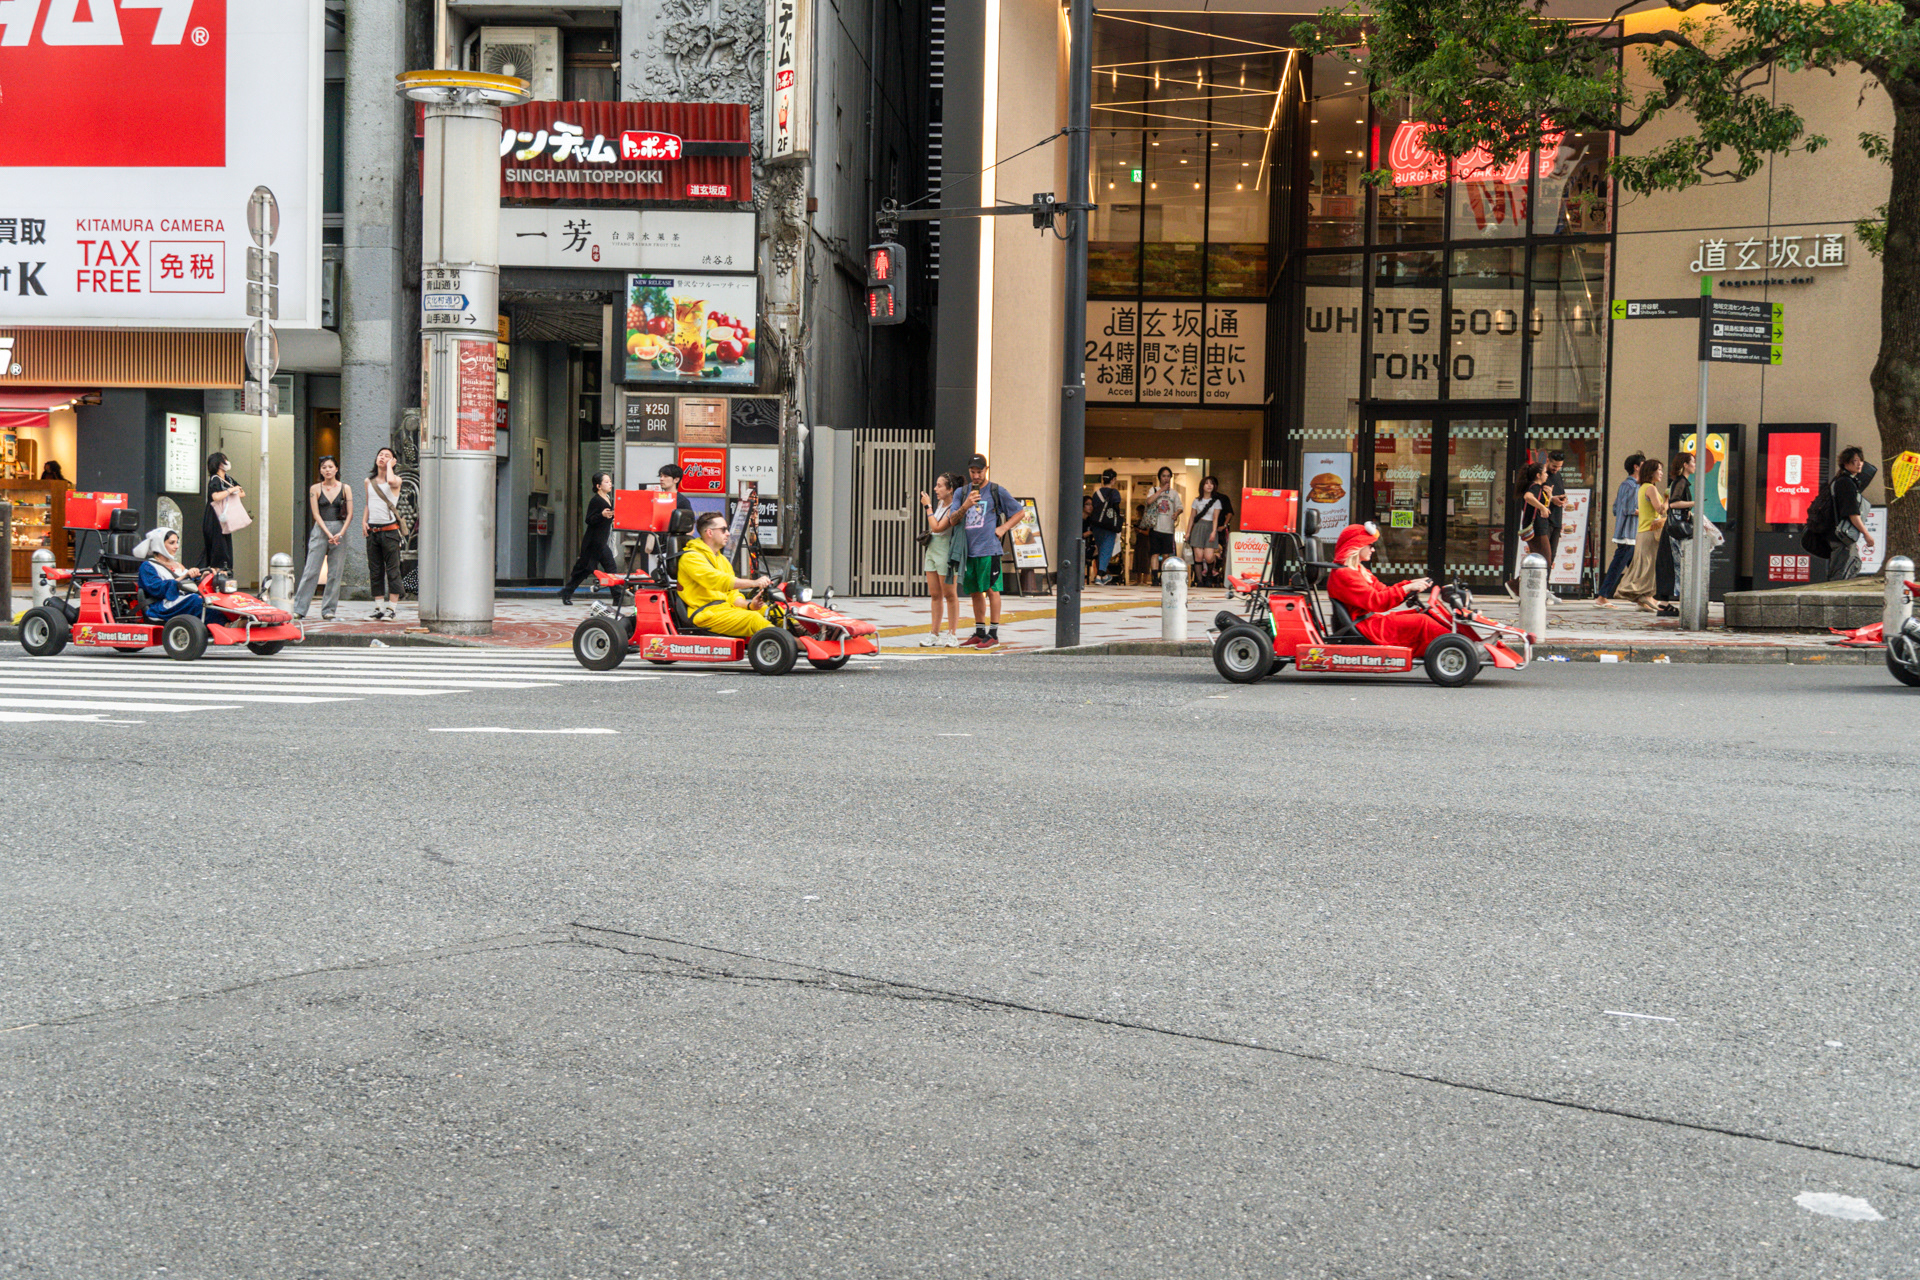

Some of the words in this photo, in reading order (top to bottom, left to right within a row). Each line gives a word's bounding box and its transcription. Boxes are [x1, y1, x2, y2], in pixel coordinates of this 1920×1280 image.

[777, 137, 788, 152] 2F
[506, 169, 580, 183] SINCHAM
[583, 170, 663, 184] TOPPOKKI
[690, 185, 727, 196] 道玄坂店
[76, 219, 154, 232] KITAMURA
[160, 219, 225, 232] CAMERA
[516, 218, 592, 253] 一芳
[77, 240, 140, 267] TAX
[1690, 233, 1844, 273] 道玄坂通
[160, 253, 214, 279] 免税
[702, 254, 733, 266] 渋谷店
[77, 270, 141, 293] FREE
[426, 280, 460, 290] 青山通り
[426, 296, 460, 305] 文化村通り
[426, 313, 460, 324] 山手通り
[1103, 307, 1239, 338] 道玄坂通
[1085, 340, 1246, 365] 24時間ご自由に
[1097, 364, 1246, 386] お通りください
[1163, 388, 1173, 397] 24
[1175, 388, 1197, 397] hours
[1213, 389, 1230, 399] day
[497, 407, 507, 424] 2F
[628, 406, 639, 414] 4F
[645, 403, 670, 415] ¥250
[647, 418, 667, 431] BAR
[734, 465, 774, 473] SKYPIA
[709, 481, 721, 489] 2F
[1775, 486, 1796, 495] Gong
[1796, 485, 1810, 493] cha
[97, 631, 117, 640] Street
[117, 632, 131, 641] Kart
[131, 633, 149, 642] .com
[669, 643, 693, 654] Street
[694, 644, 711, 654] Kart
[711, 646, 731, 655] .com
[1331, 654, 1361, 665] Street
[1361, 655, 1382, 666] Kart
[1382, 657, 1406, 667] .com
